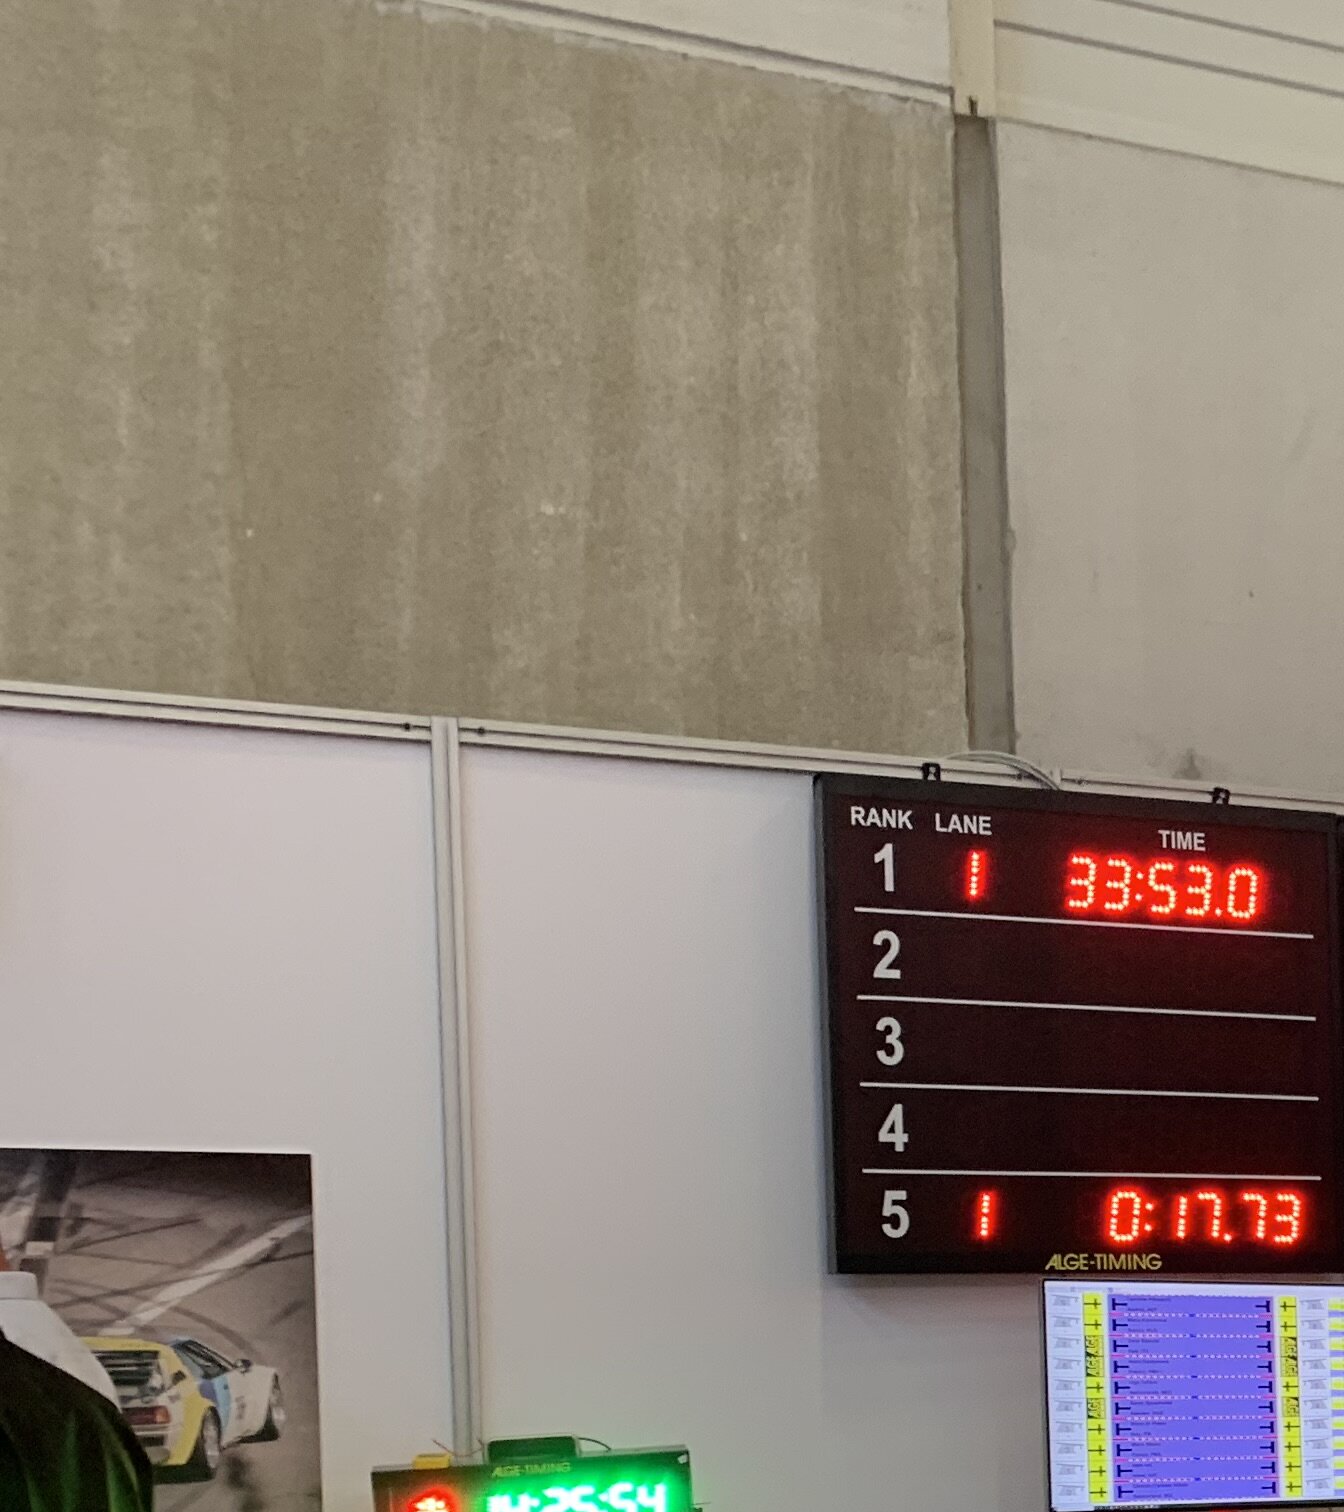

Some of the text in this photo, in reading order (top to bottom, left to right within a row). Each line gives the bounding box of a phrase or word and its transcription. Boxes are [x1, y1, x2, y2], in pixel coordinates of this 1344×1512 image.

[850, 806, 1205, 851] RANK LANE TIME
[874, 844, 1258, 918] 1 1 33:53.0
[873, 931, 901, 980] 2
[876, 1017, 904, 1066] 3
[878, 1104, 908, 1152] 4
[881, 1191, 1301, 1243] 5 1 0:17.73
[1045, 1254, 1162, 1271] ALGE-TIMING
